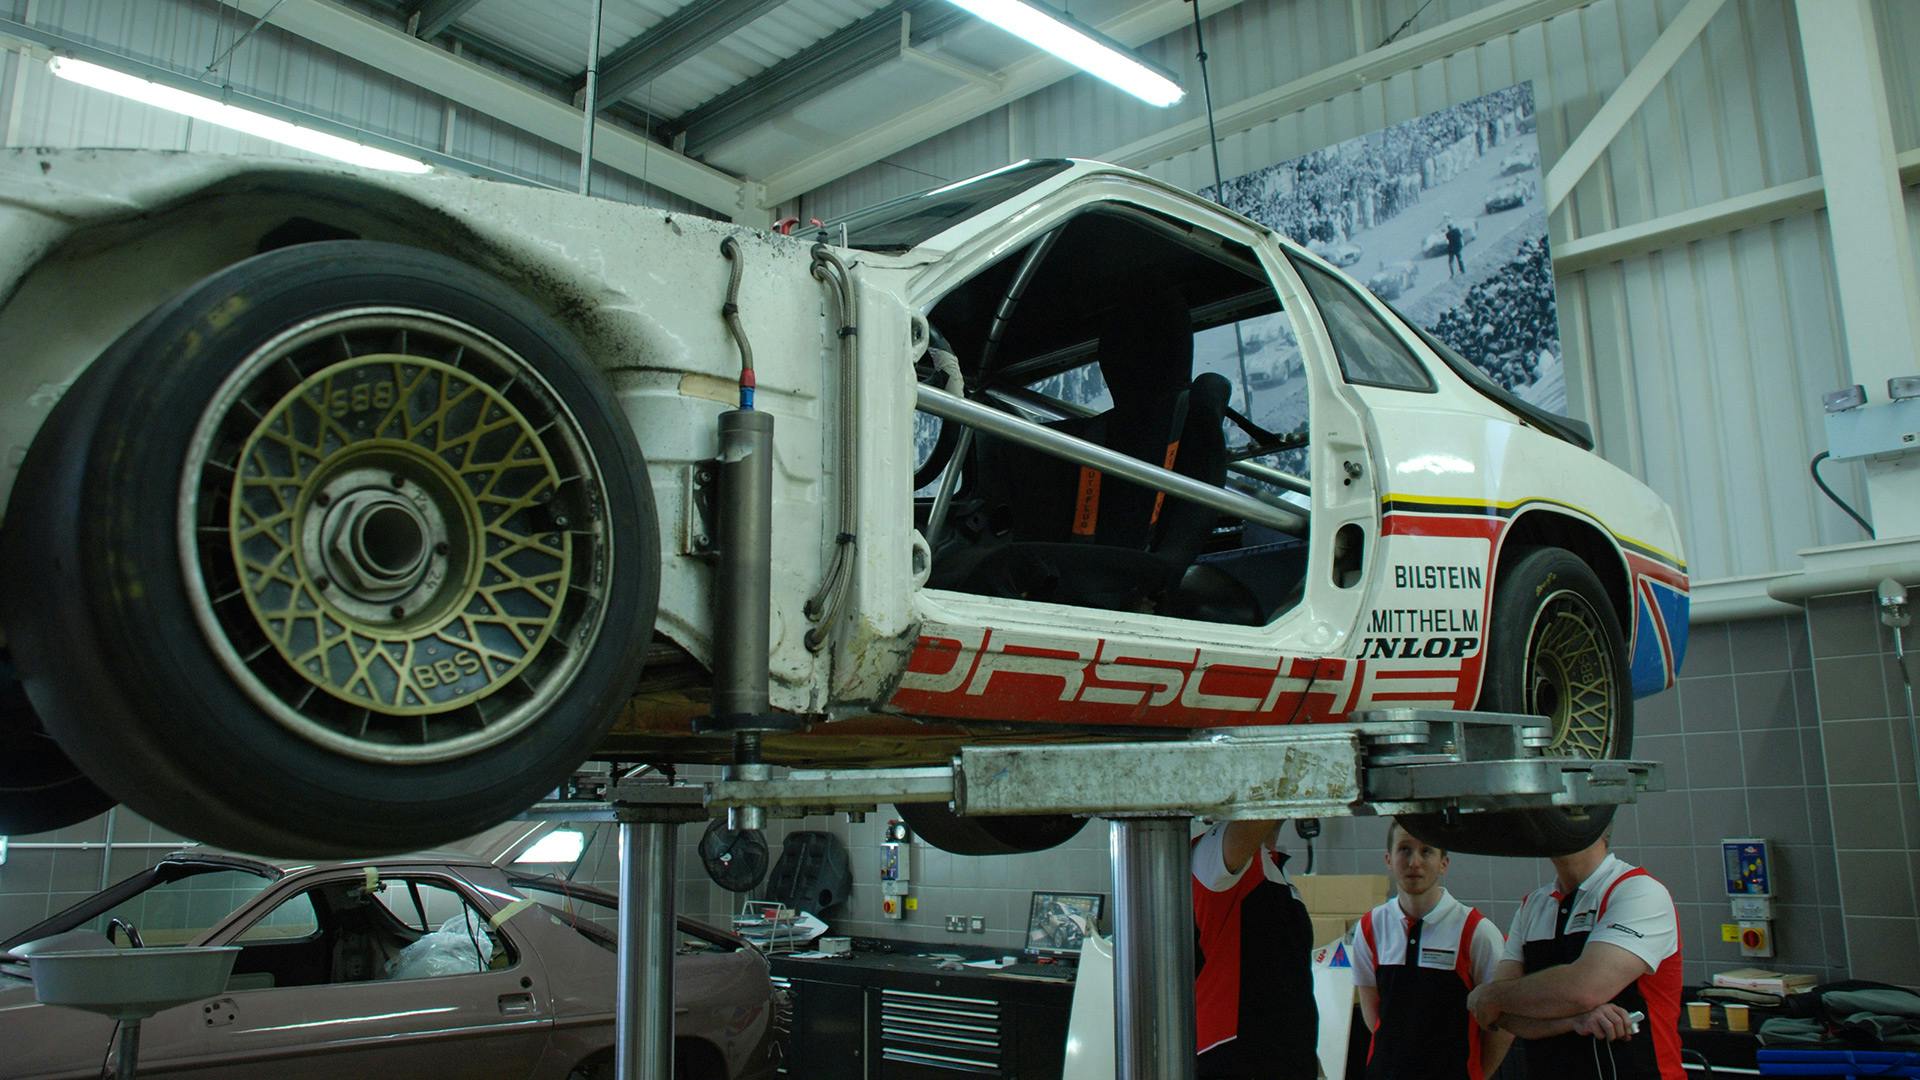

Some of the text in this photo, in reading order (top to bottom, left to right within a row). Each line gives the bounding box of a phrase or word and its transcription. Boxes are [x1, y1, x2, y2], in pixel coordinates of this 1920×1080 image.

[1395, 565, 1482, 589] BILSTEIN
[1367, 609, 1478, 633] MITTHELM
[413, 650, 482, 690] BBS
